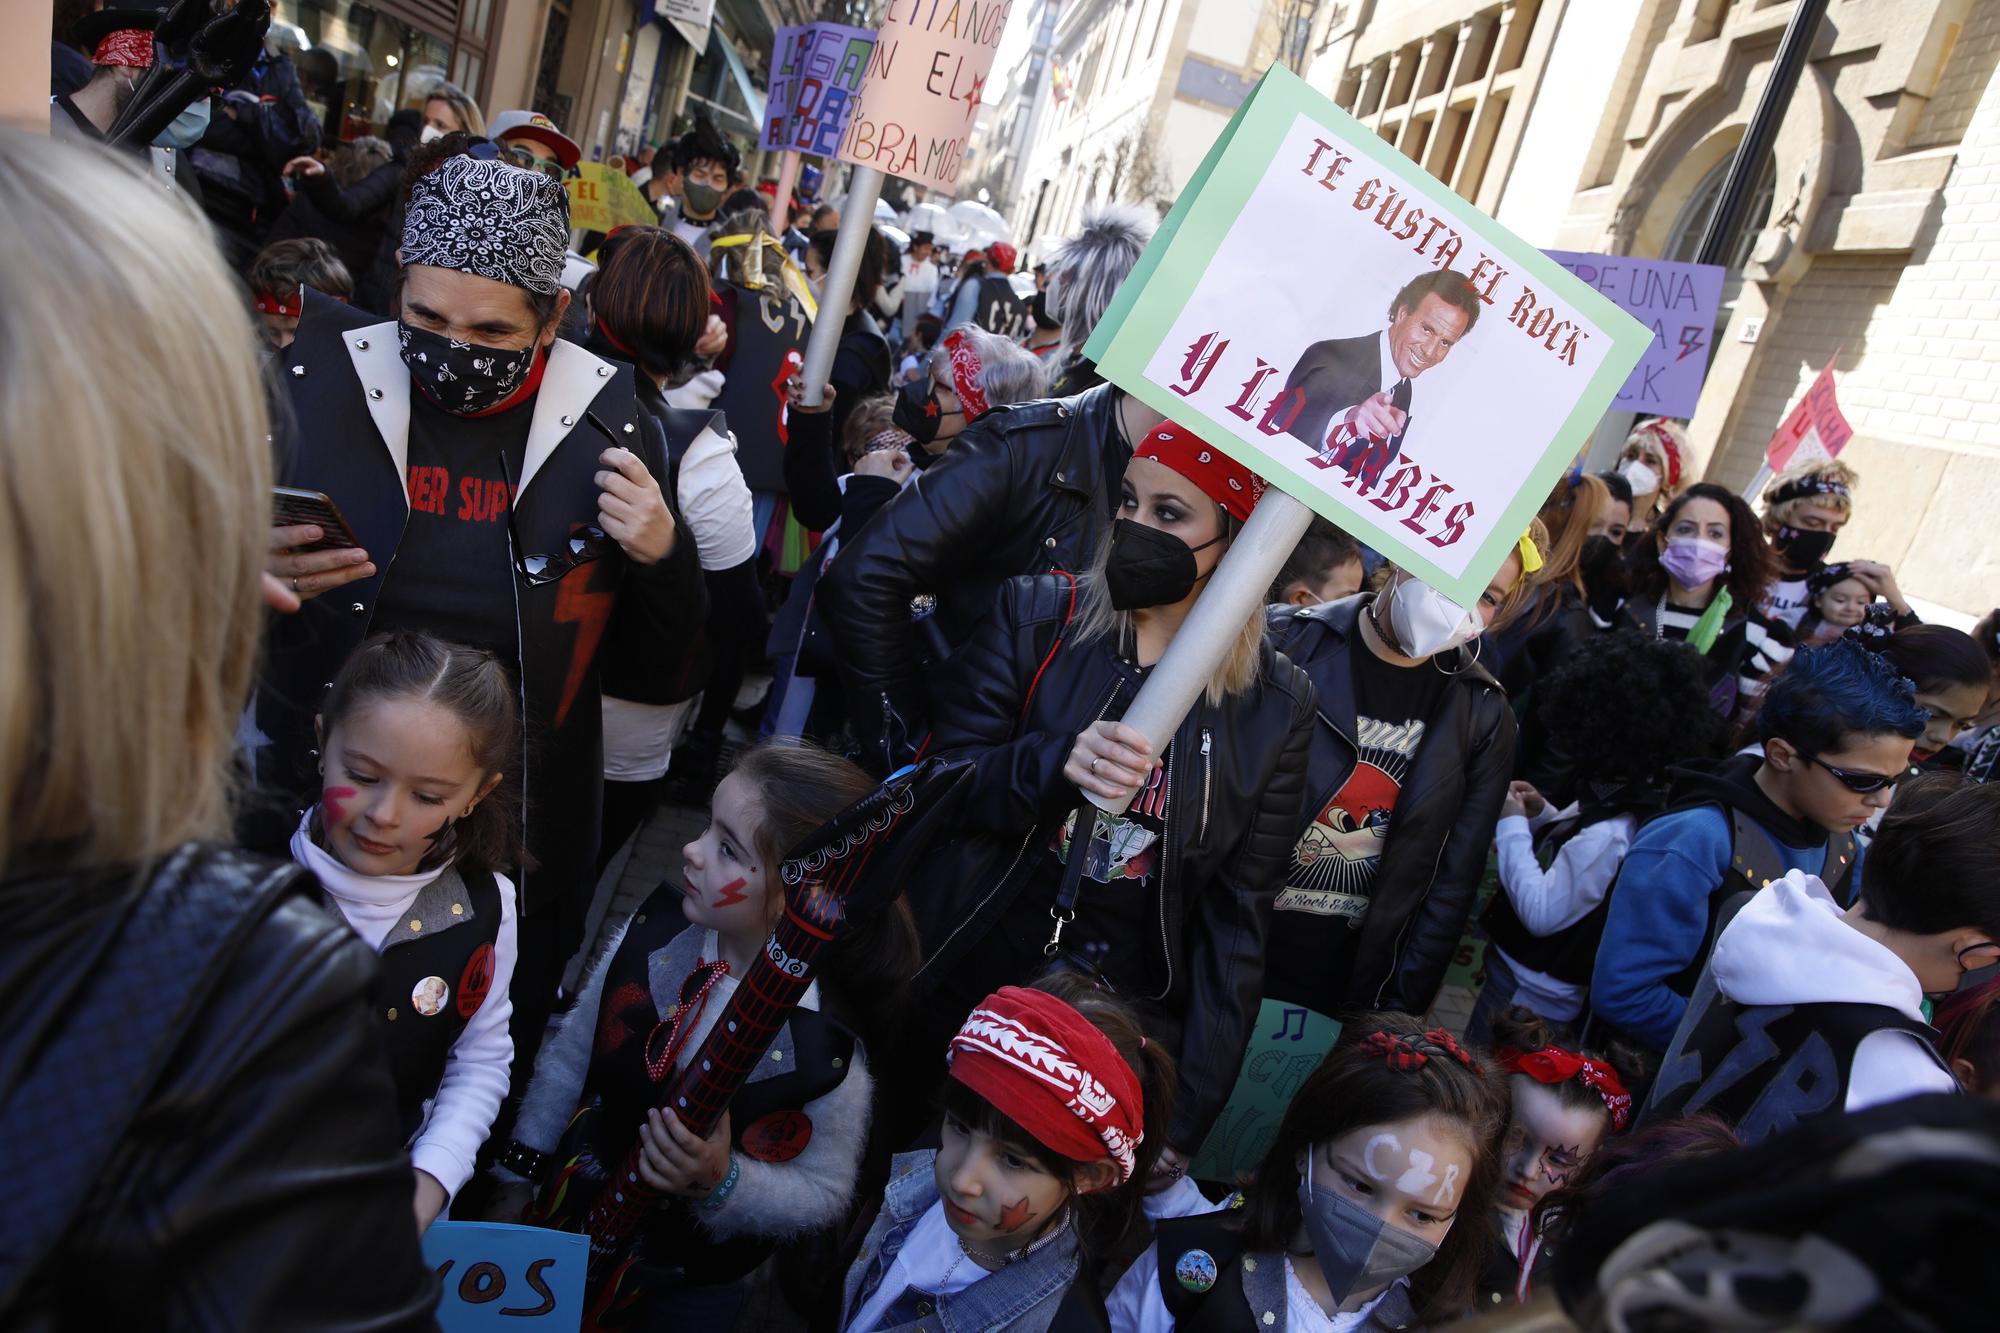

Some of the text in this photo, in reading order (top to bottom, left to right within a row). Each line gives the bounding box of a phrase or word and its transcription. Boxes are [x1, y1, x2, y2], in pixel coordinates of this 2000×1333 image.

[926, 51, 960, 101] EL
[841, 121, 967, 184] IBRAMOS
[1301, 138, 1590, 366] TE GUSTA EL ROCK
[1628, 268, 1698, 312] UNA
[1168, 331, 1475, 547] Y LO SABES
[458, 476, 518, 522] SUP
